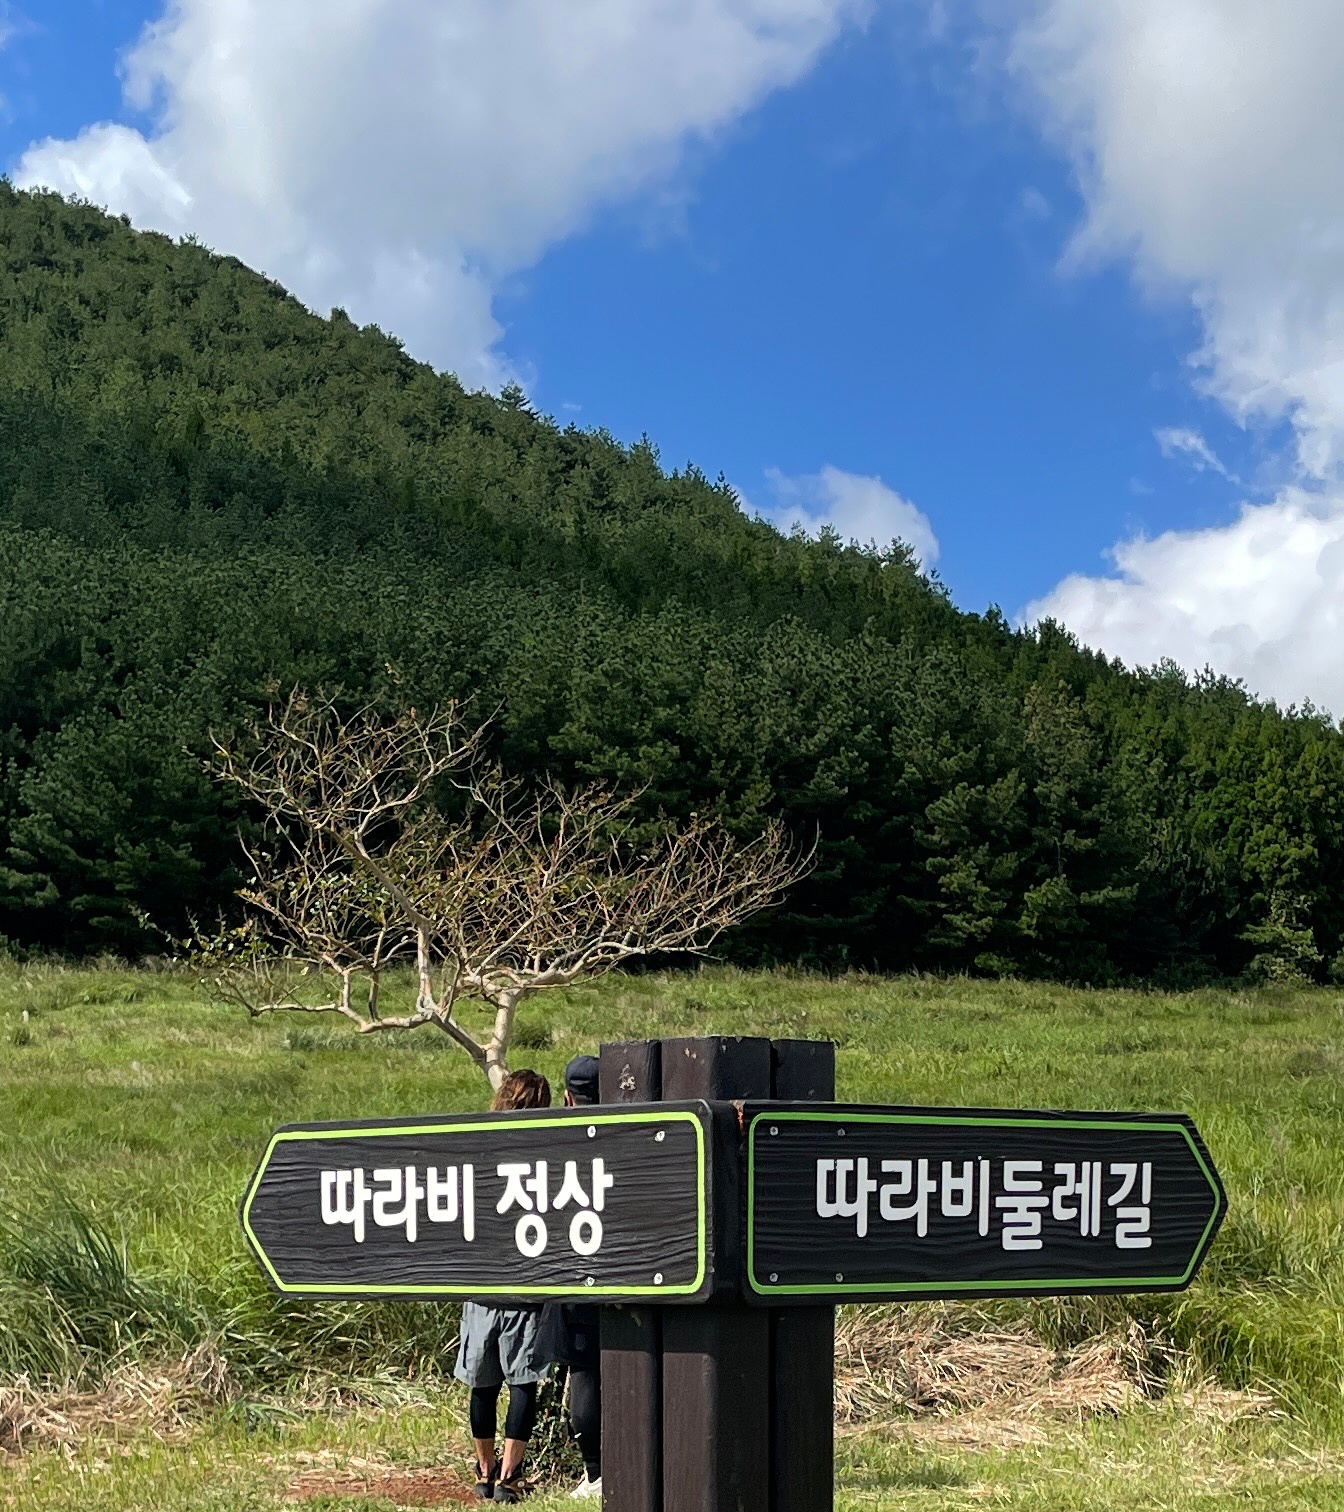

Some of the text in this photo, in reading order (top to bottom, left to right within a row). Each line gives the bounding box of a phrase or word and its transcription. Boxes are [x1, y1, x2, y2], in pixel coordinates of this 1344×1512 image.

[320, 1157, 614, 1258] 따라비 정상
[816, 1157, 1152, 1251] 따라비둘레길
